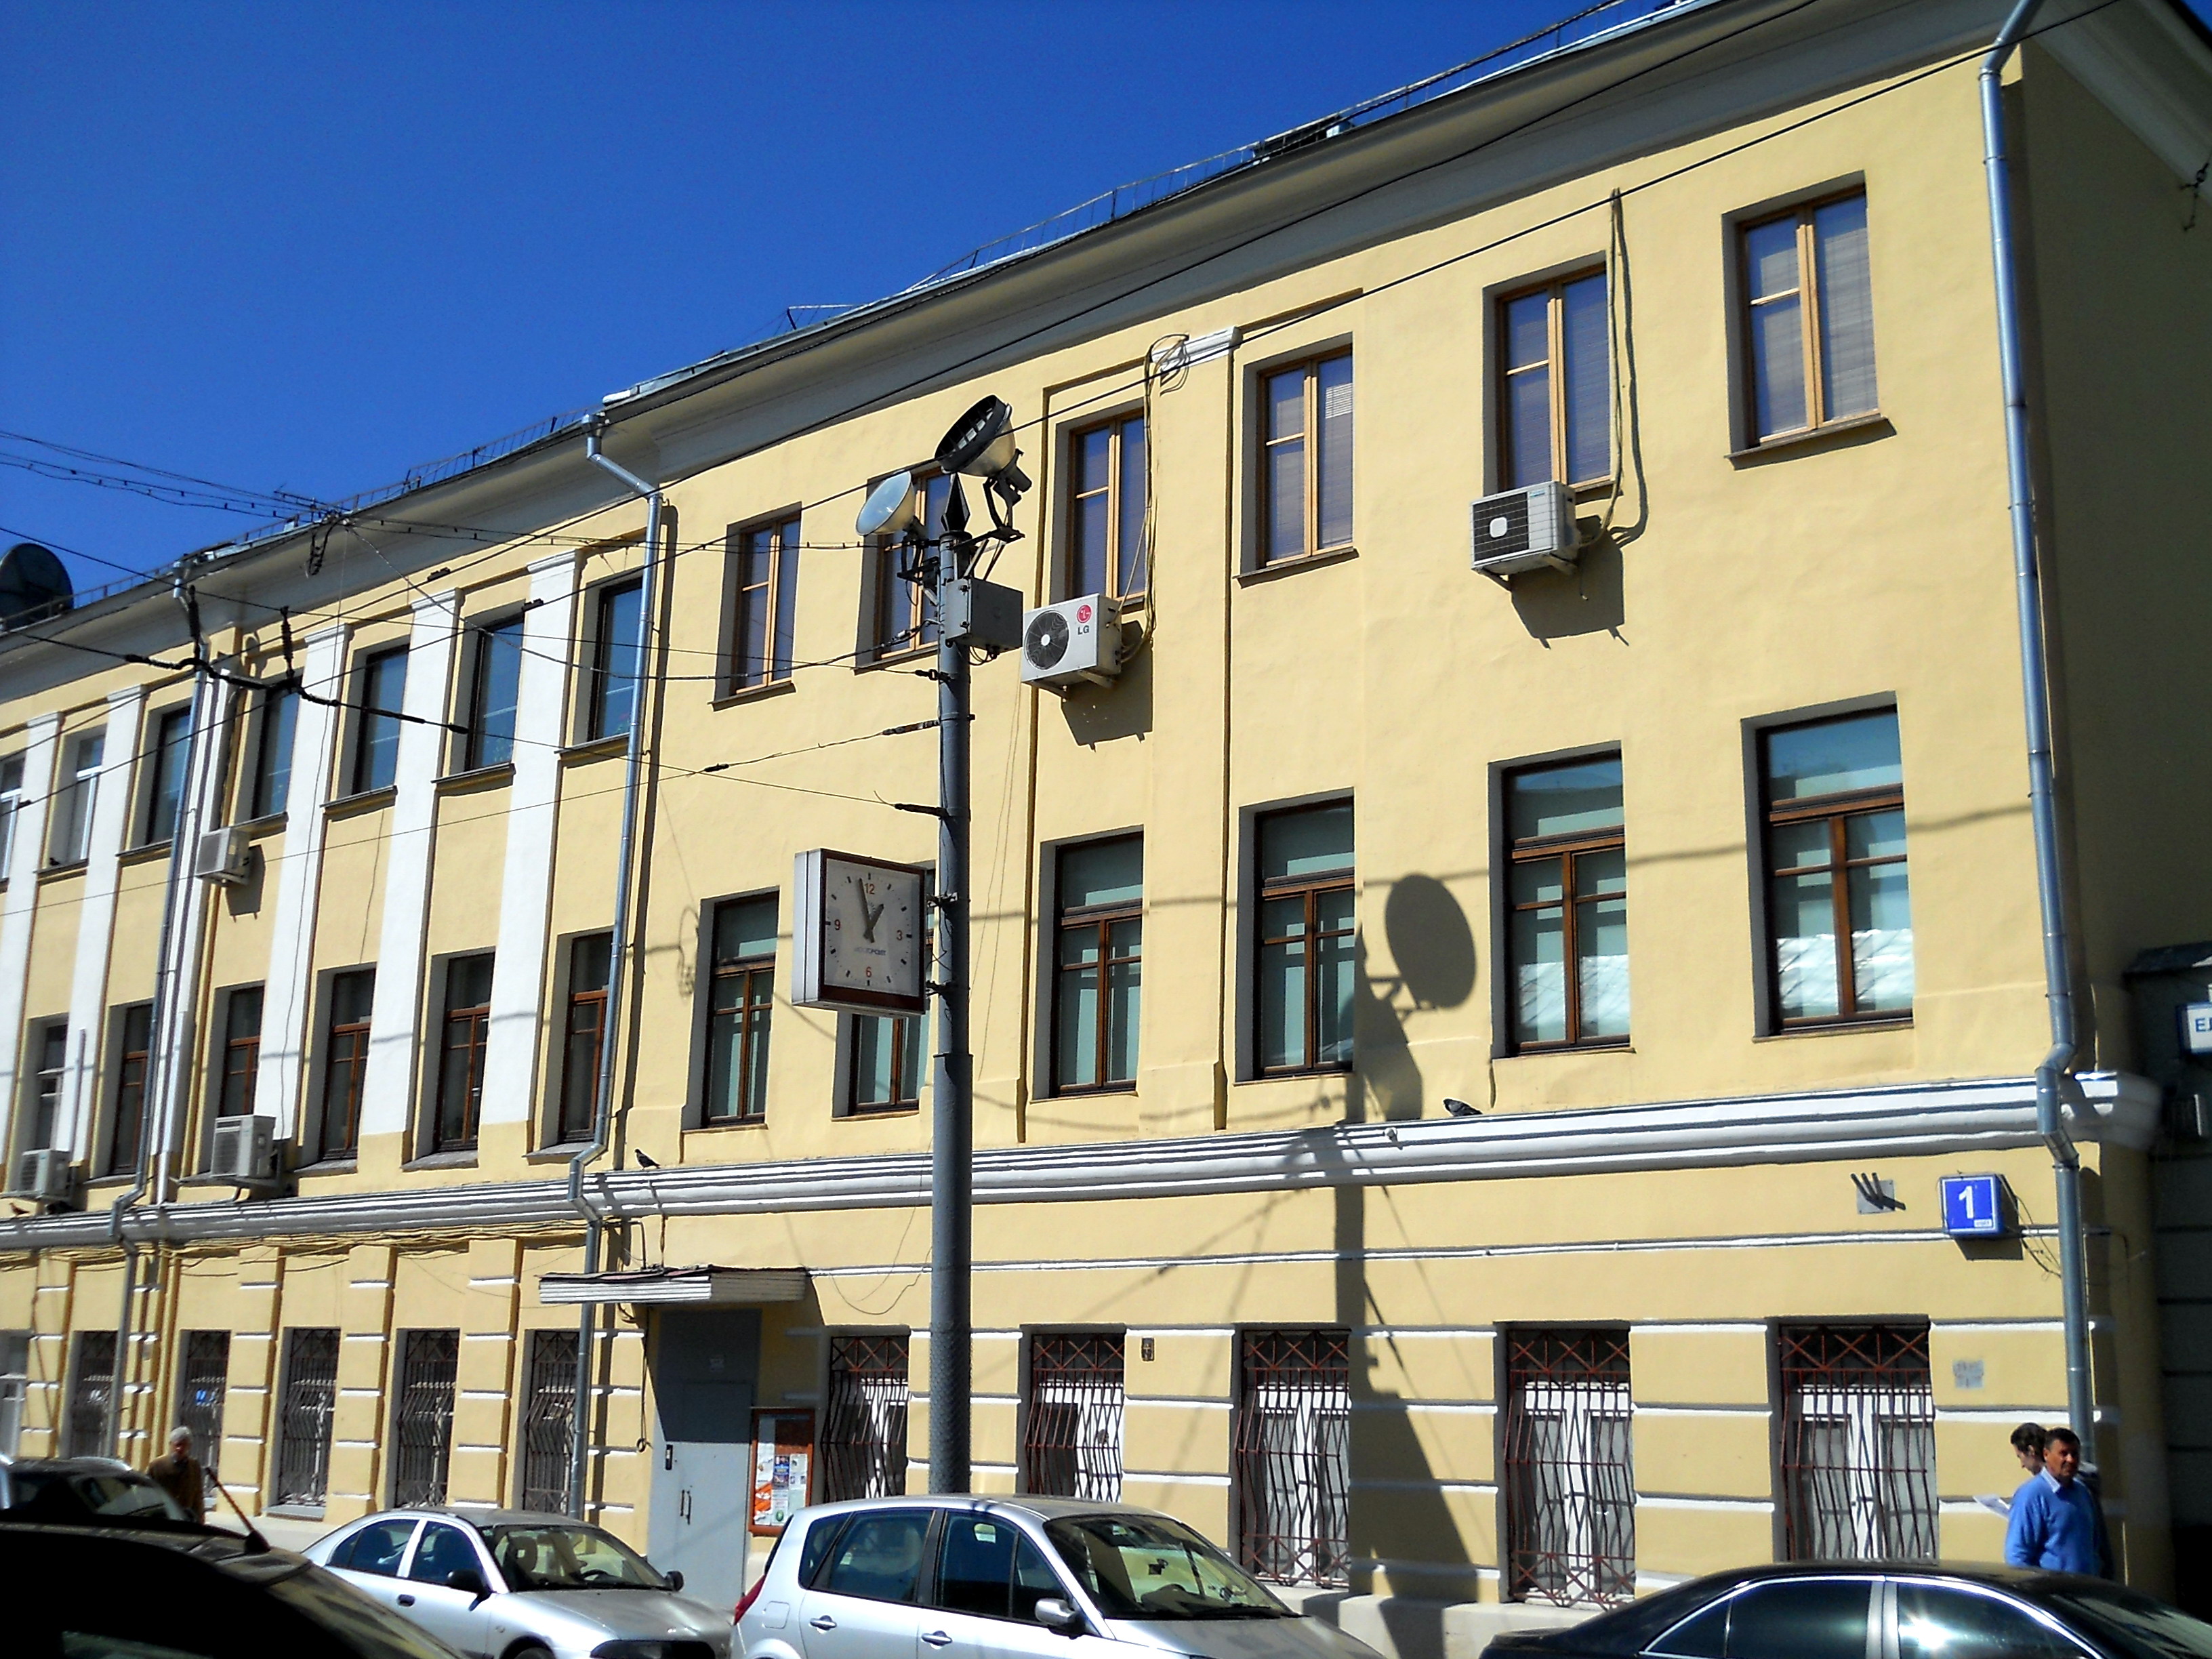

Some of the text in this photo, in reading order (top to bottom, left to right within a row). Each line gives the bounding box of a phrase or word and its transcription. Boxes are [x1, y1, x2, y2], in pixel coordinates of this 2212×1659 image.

[1078, 624, 1090, 636] LG
[864, 883, 875, 895] 12
[834, 919, 841, 930] 9
[896, 929, 903, 941] 3
[865, 966, 872, 978] 6
[1959, 1185, 1973, 1218] 1
